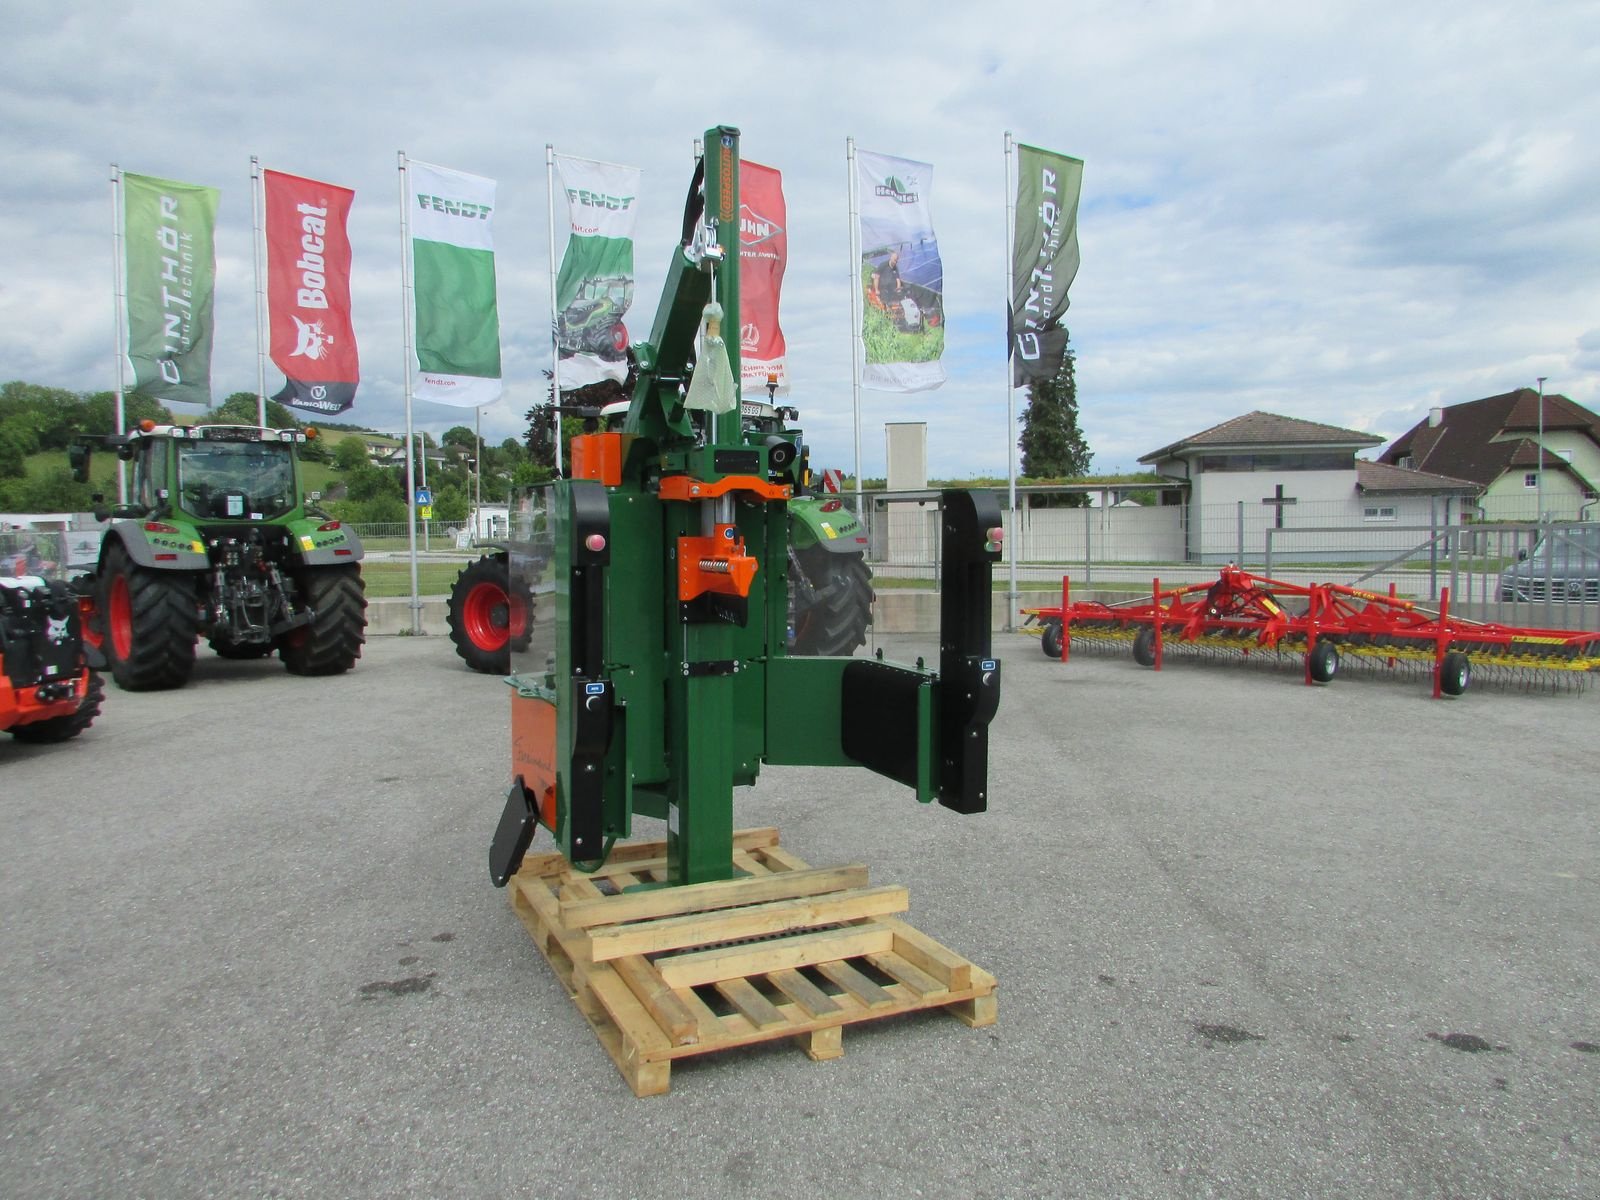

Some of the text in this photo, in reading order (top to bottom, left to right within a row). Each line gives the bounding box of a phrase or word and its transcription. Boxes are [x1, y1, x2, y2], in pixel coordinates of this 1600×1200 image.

[417, 194, 492, 220] FENDT
[567, 188, 635, 211] FENDT
[740, 218, 770, 237] UHN
[297, 202, 329, 310] Bobcat
